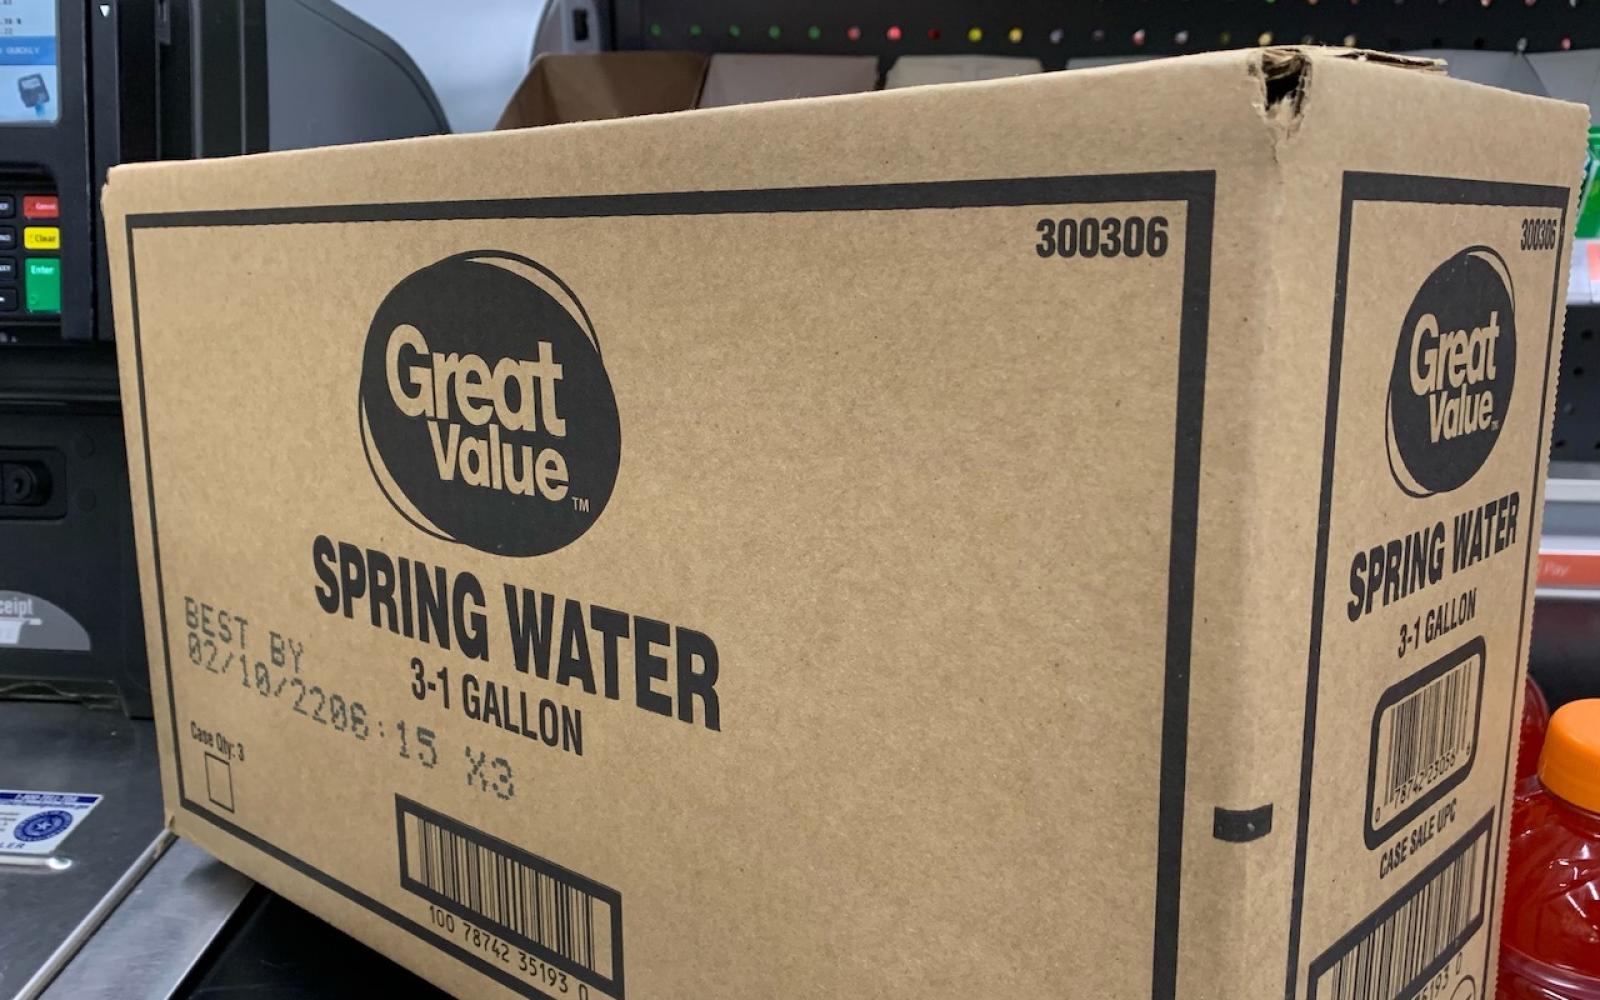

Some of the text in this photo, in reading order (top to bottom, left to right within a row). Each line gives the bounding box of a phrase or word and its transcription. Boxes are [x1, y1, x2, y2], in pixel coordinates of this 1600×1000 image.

[30, 264, 54, 274] Enter
[34, 234, 55, 242] Clear
[1036, 216, 1169, 258] 300306
[1521, 218, 1557, 250] 300306
[386, 323, 566, 437] Great
[1409, 311, 1499, 396] Great
[1429, 383, 1494, 443] Value
[428, 420, 590, 512] Value TM
[1347, 491, 1520, 622] SPRING WATER
[185, 596, 304, 674] BEST BY
[313, 534, 721, 731] SPRING WATER
[1398, 587, 1477, 658] 3-1 GALLON
[190, 720, 213, 748] Case
[237, 743, 244, 761] 3
[411, 657, 583, 756] 3-1 GALLON
[465, 746, 514, 800] X3
[1380, 798, 1457, 879] CASE SALE UPC
[430, 906, 455, 933] 100
[463, 923, 510, 963] 78742
[518, 951, 568, 993] 35193
